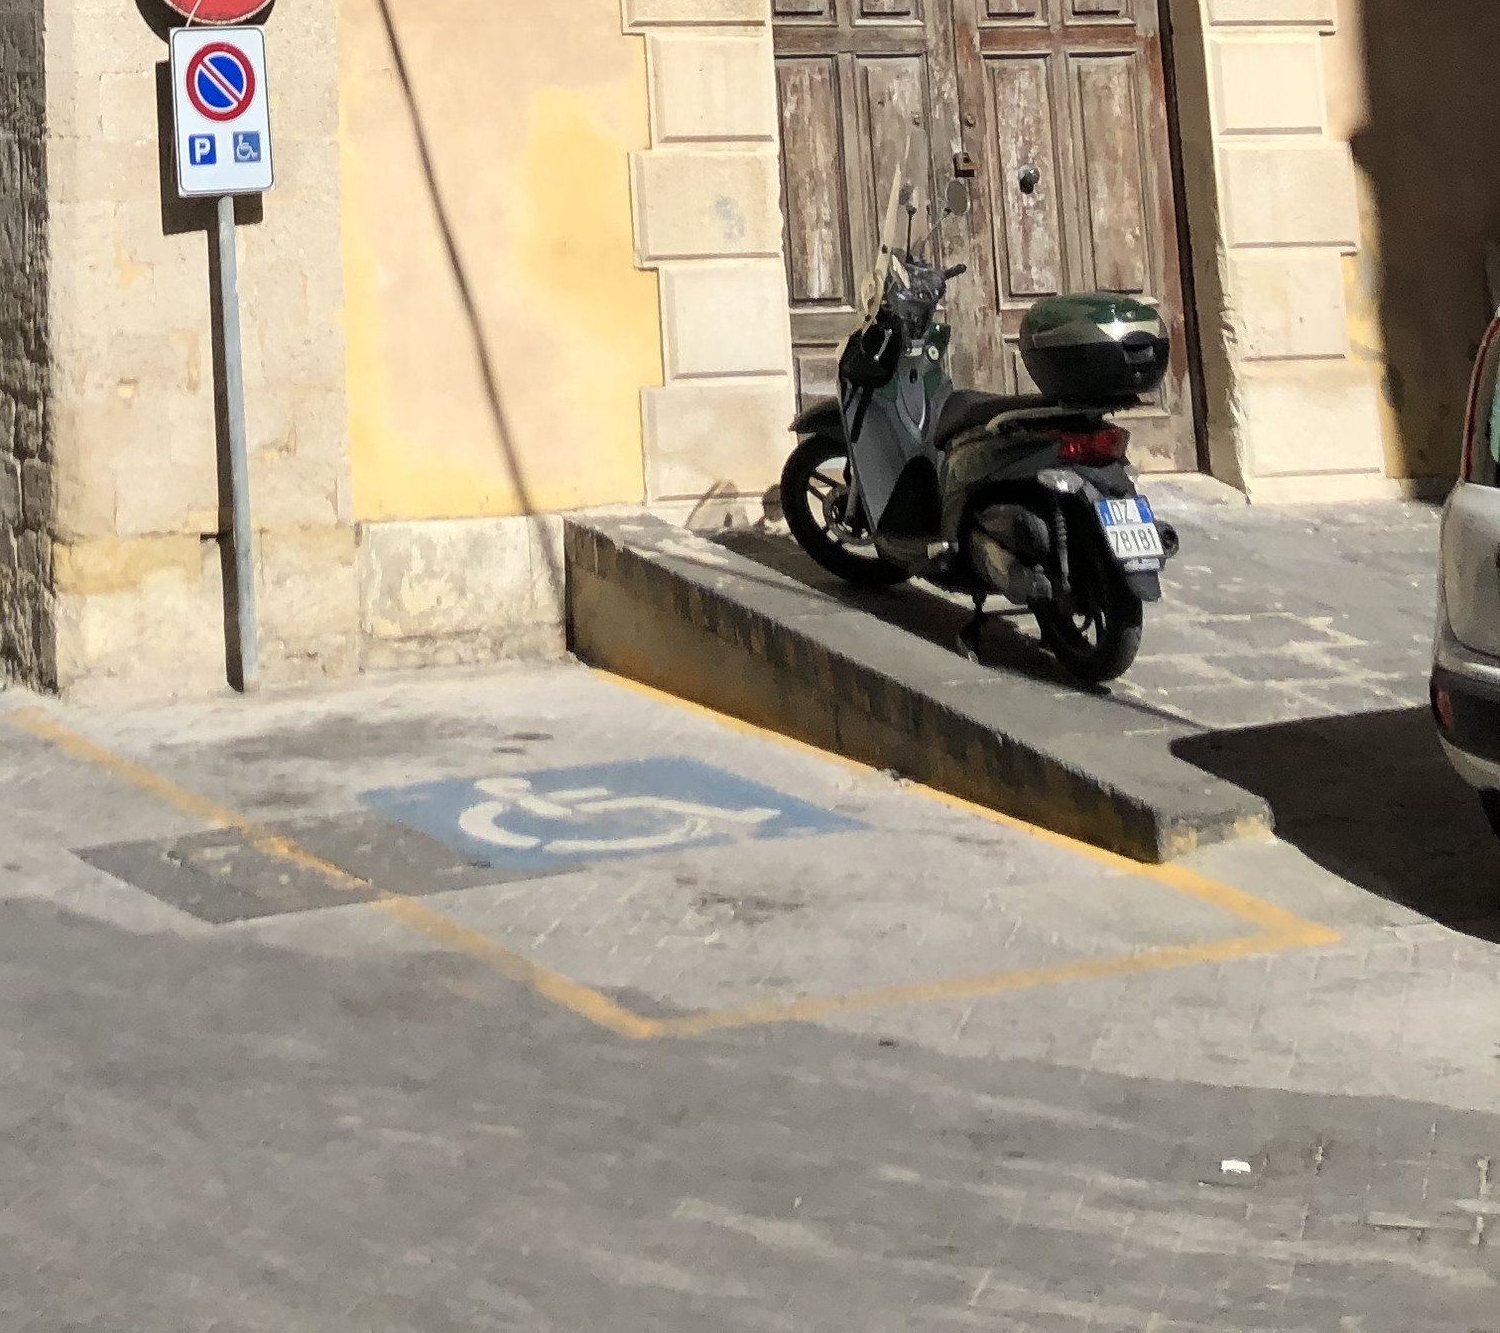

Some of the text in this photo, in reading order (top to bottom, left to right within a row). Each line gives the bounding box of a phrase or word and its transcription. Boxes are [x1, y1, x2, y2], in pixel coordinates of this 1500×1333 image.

[194, 137, 211, 164] P
[1110, 500, 1134, 523] DZ
[1110, 528, 1158, 553] 78181
